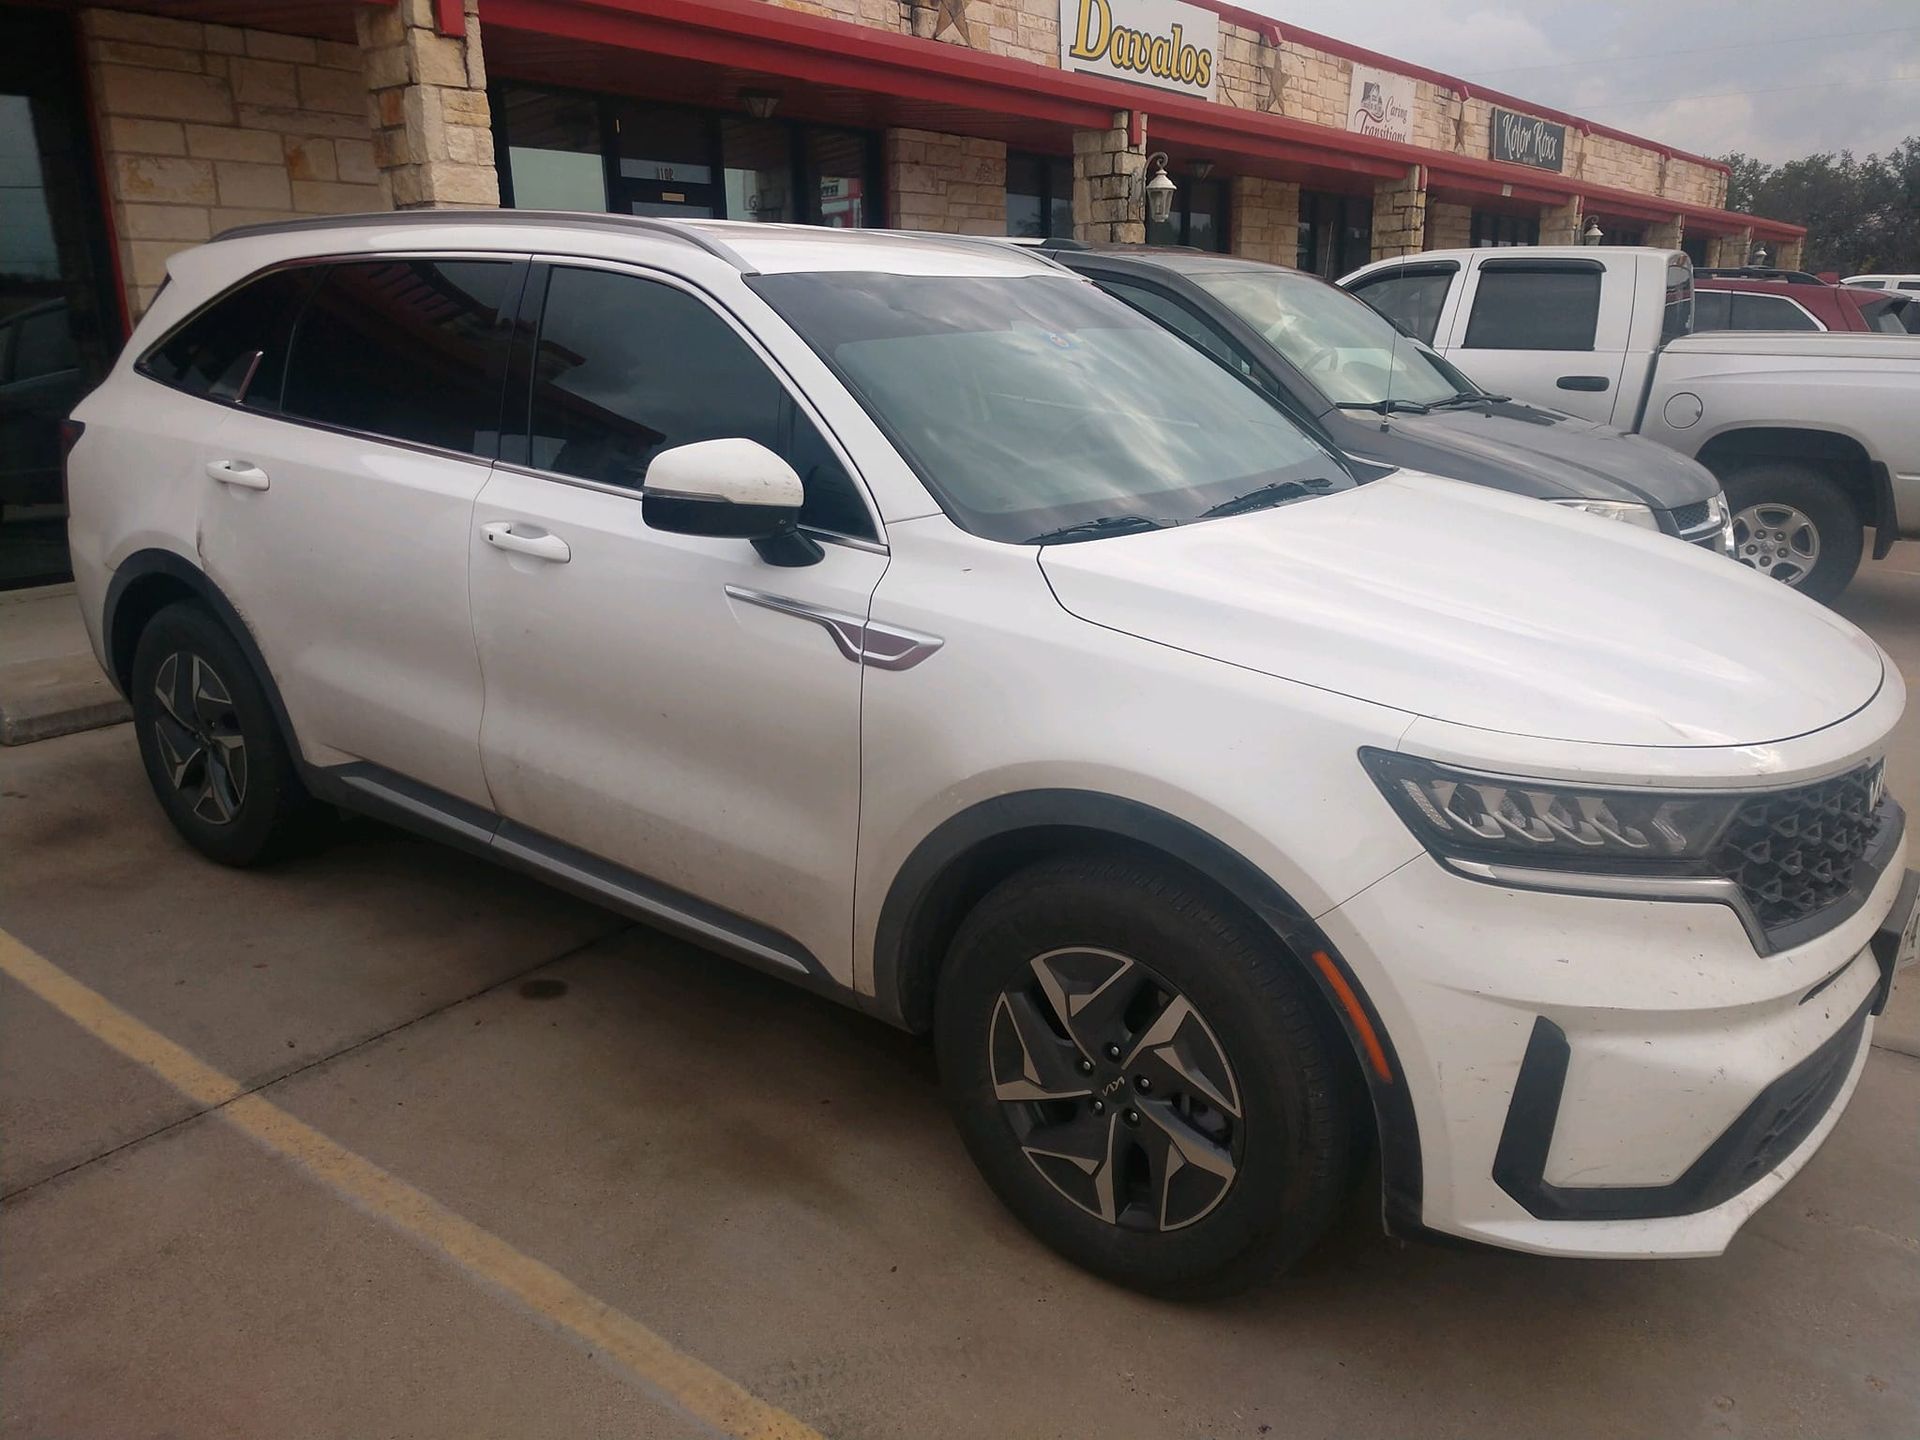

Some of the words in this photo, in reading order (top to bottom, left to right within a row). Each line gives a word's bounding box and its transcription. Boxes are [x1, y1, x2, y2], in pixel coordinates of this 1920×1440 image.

[1069, 0, 1212, 88] Davalos
[1385, 95, 1408, 125] Caring
[1502, 114, 1532, 160] Kolor
